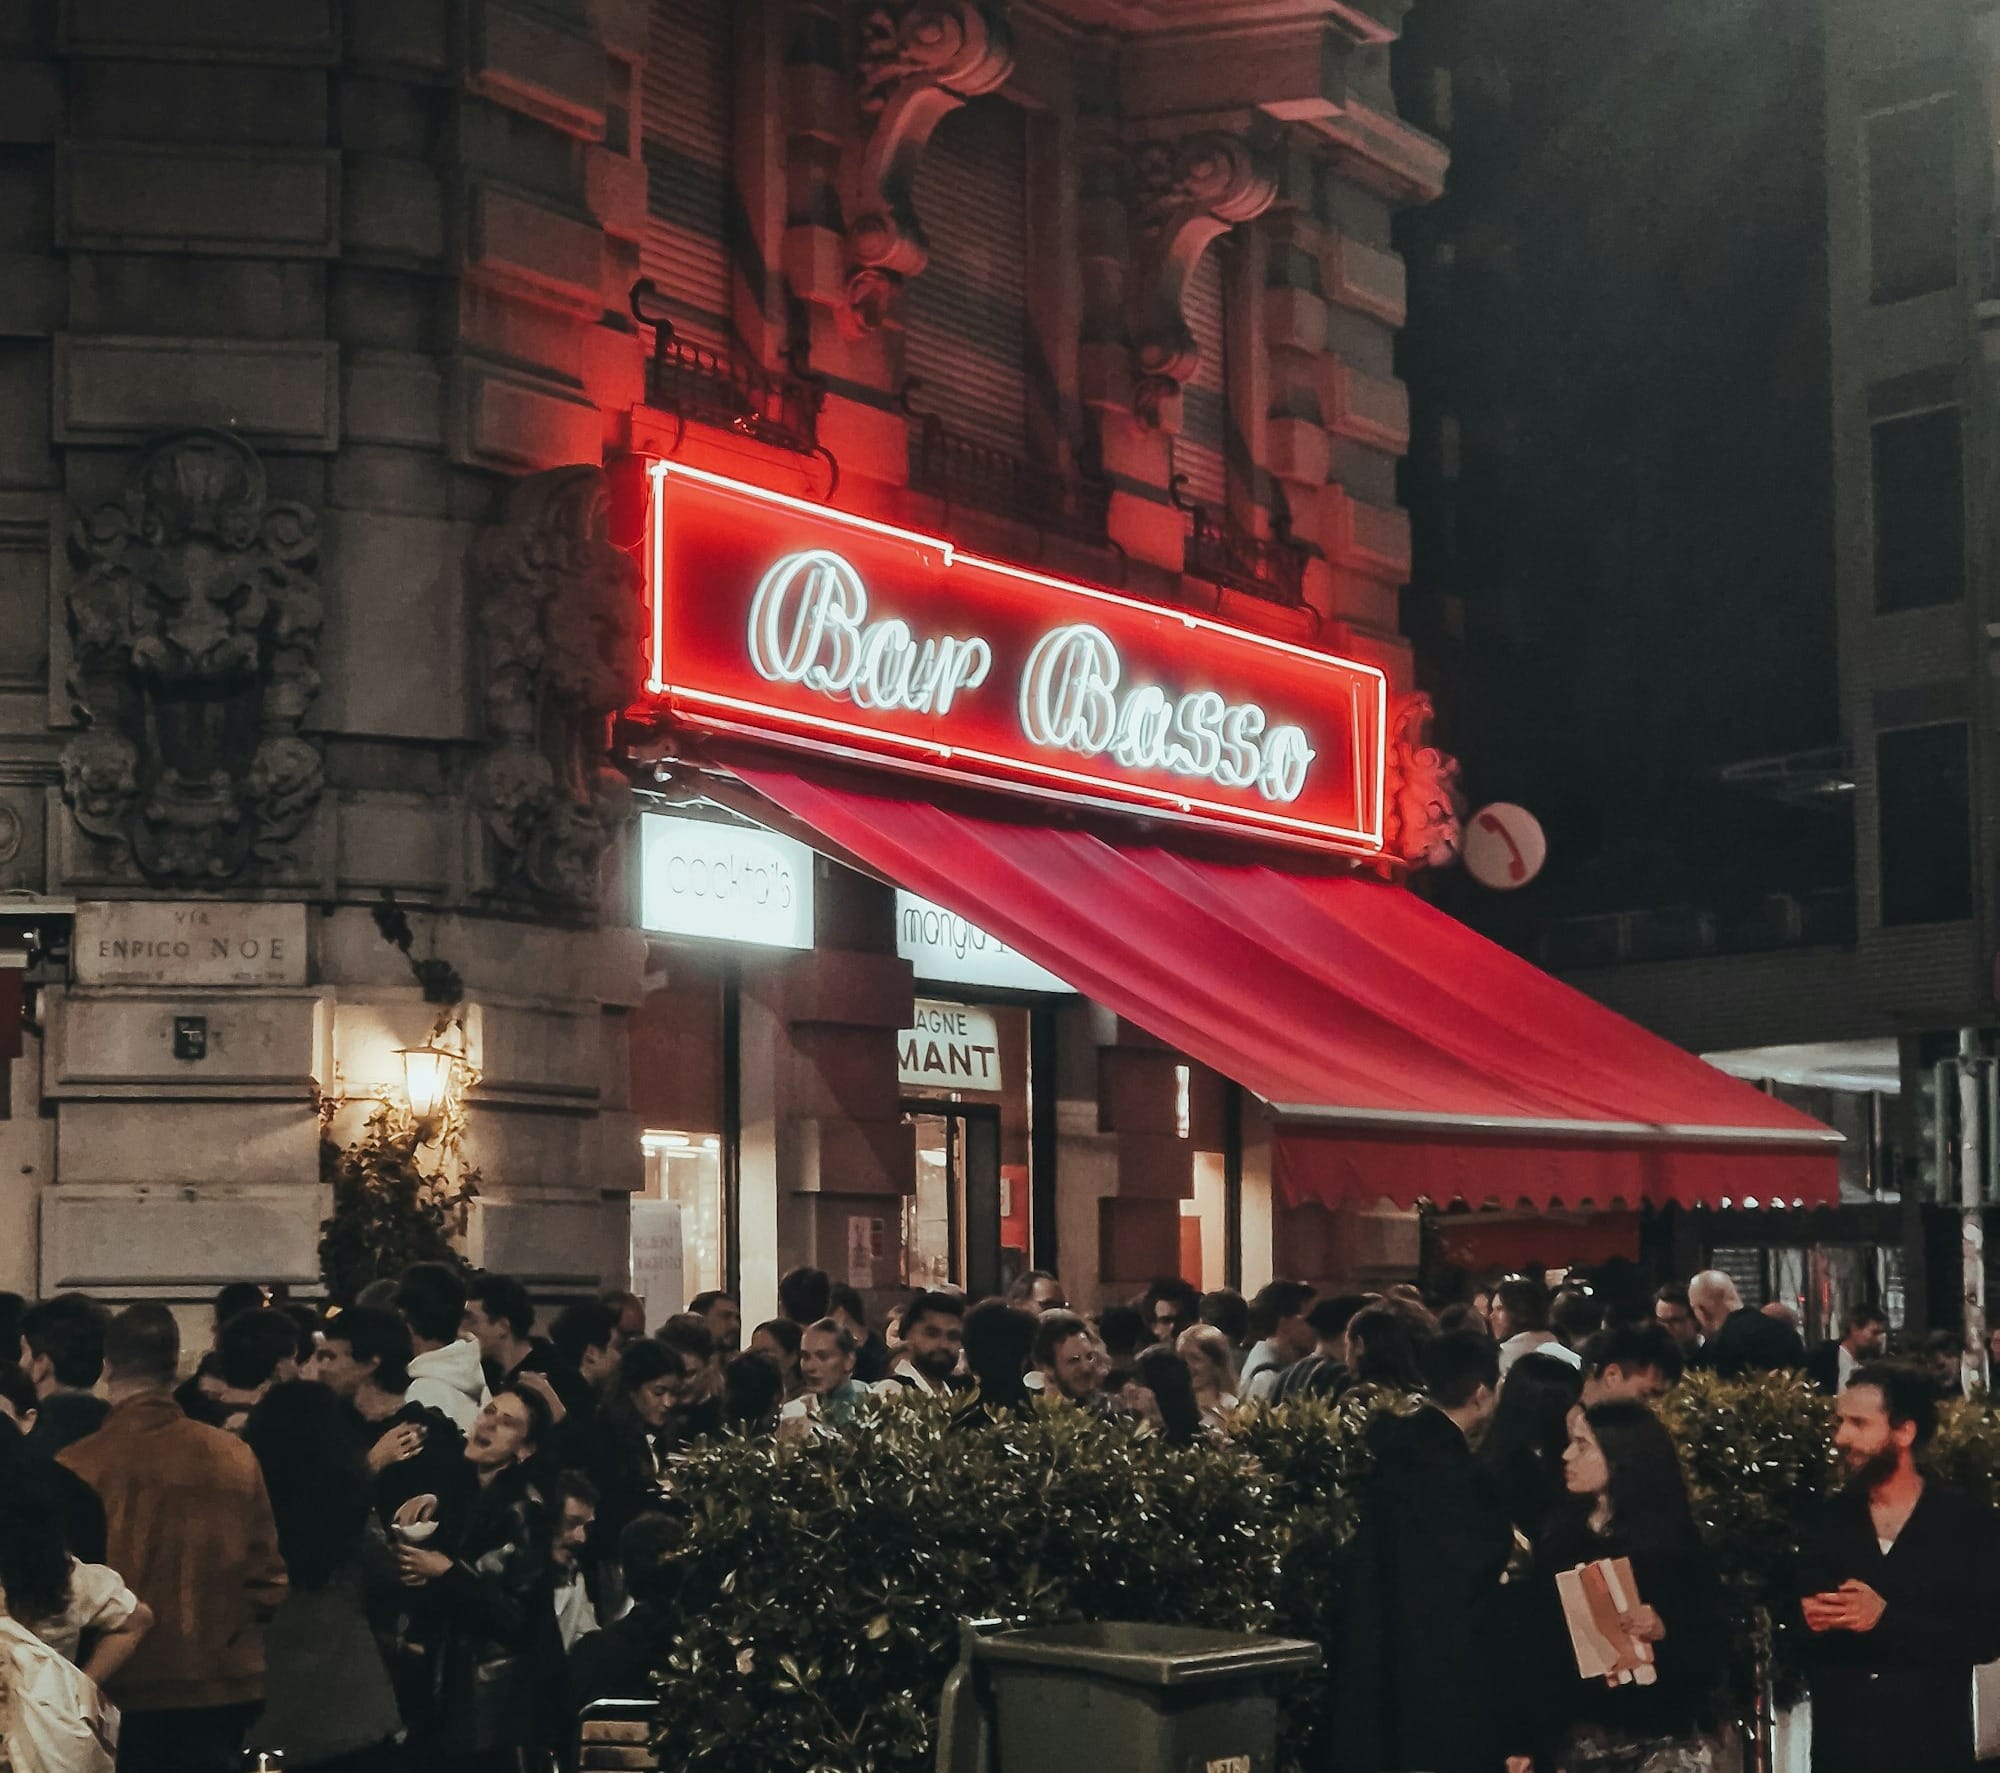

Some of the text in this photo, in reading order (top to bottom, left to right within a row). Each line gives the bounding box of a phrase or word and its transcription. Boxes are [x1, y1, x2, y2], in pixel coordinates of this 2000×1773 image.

[748, 549, 1316, 803] Bar Basso
[174, 910, 210, 926] VIA
[98, 938, 191, 960] ENRICO
